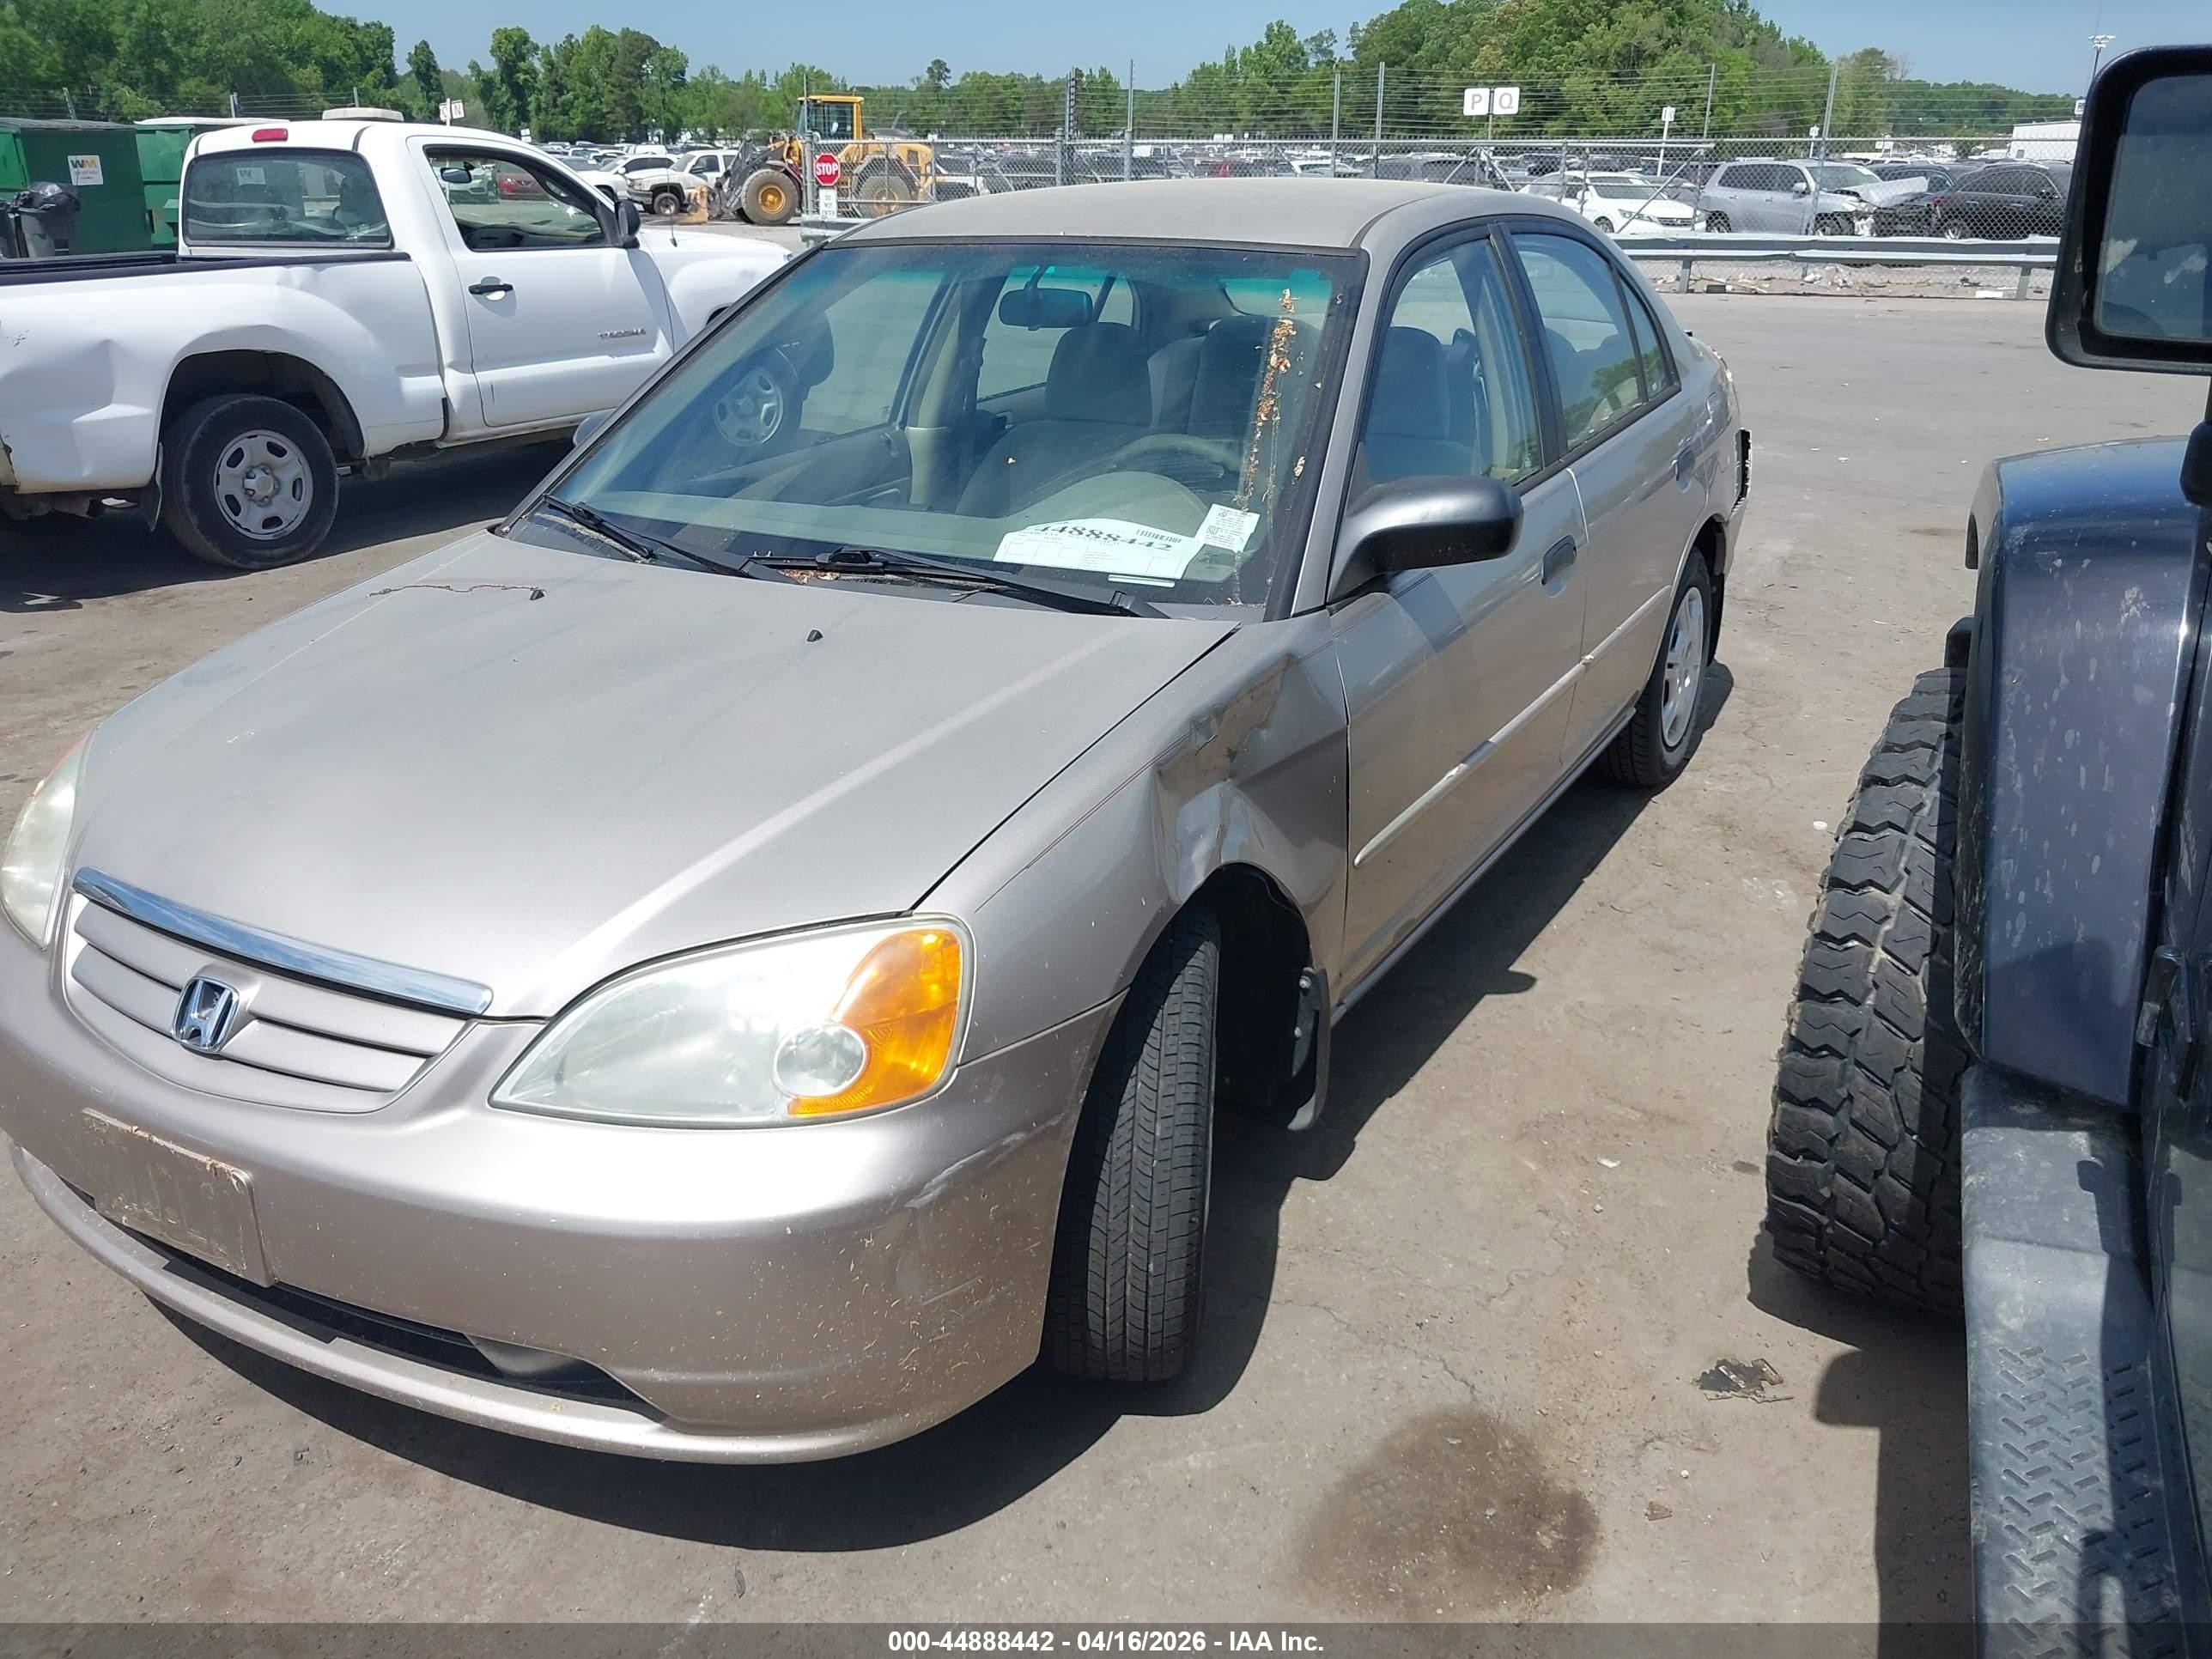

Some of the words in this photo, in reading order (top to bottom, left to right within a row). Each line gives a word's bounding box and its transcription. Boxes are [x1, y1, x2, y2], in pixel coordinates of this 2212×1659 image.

[1471, 93, 1483, 111] P
[1498, 92, 1514, 109] Q
[70, 159, 97, 169] WM
[816, 161, 839, 176] STOP
[597, 327, 647, 339] TACOMA
